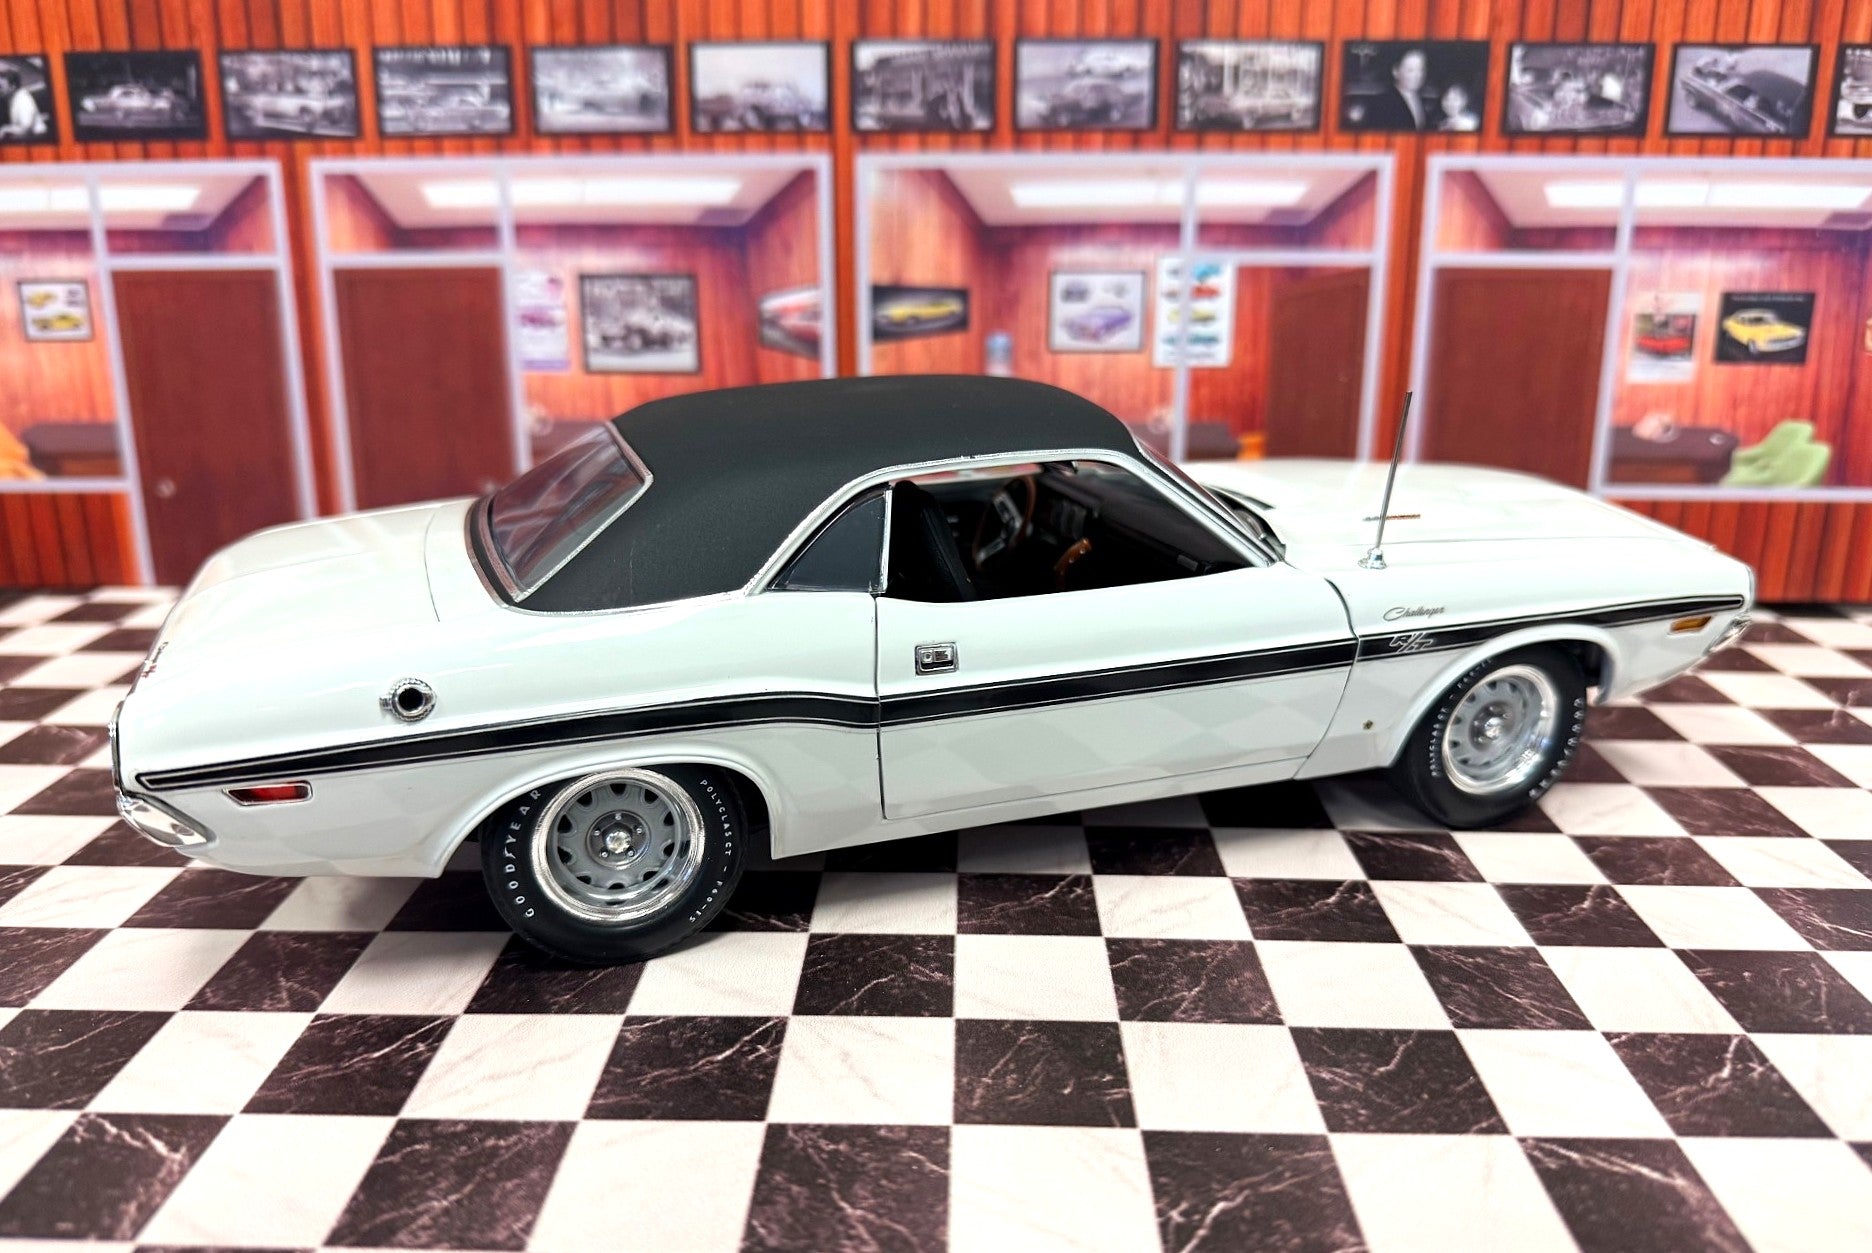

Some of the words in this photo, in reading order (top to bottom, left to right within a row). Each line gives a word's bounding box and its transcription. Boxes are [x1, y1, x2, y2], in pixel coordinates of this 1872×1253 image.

[1383, 606, 1445, 622] Challenger
[1388, 631, 1434, 653] R/T
[504, 789, 541, 918] GOODYEAR
